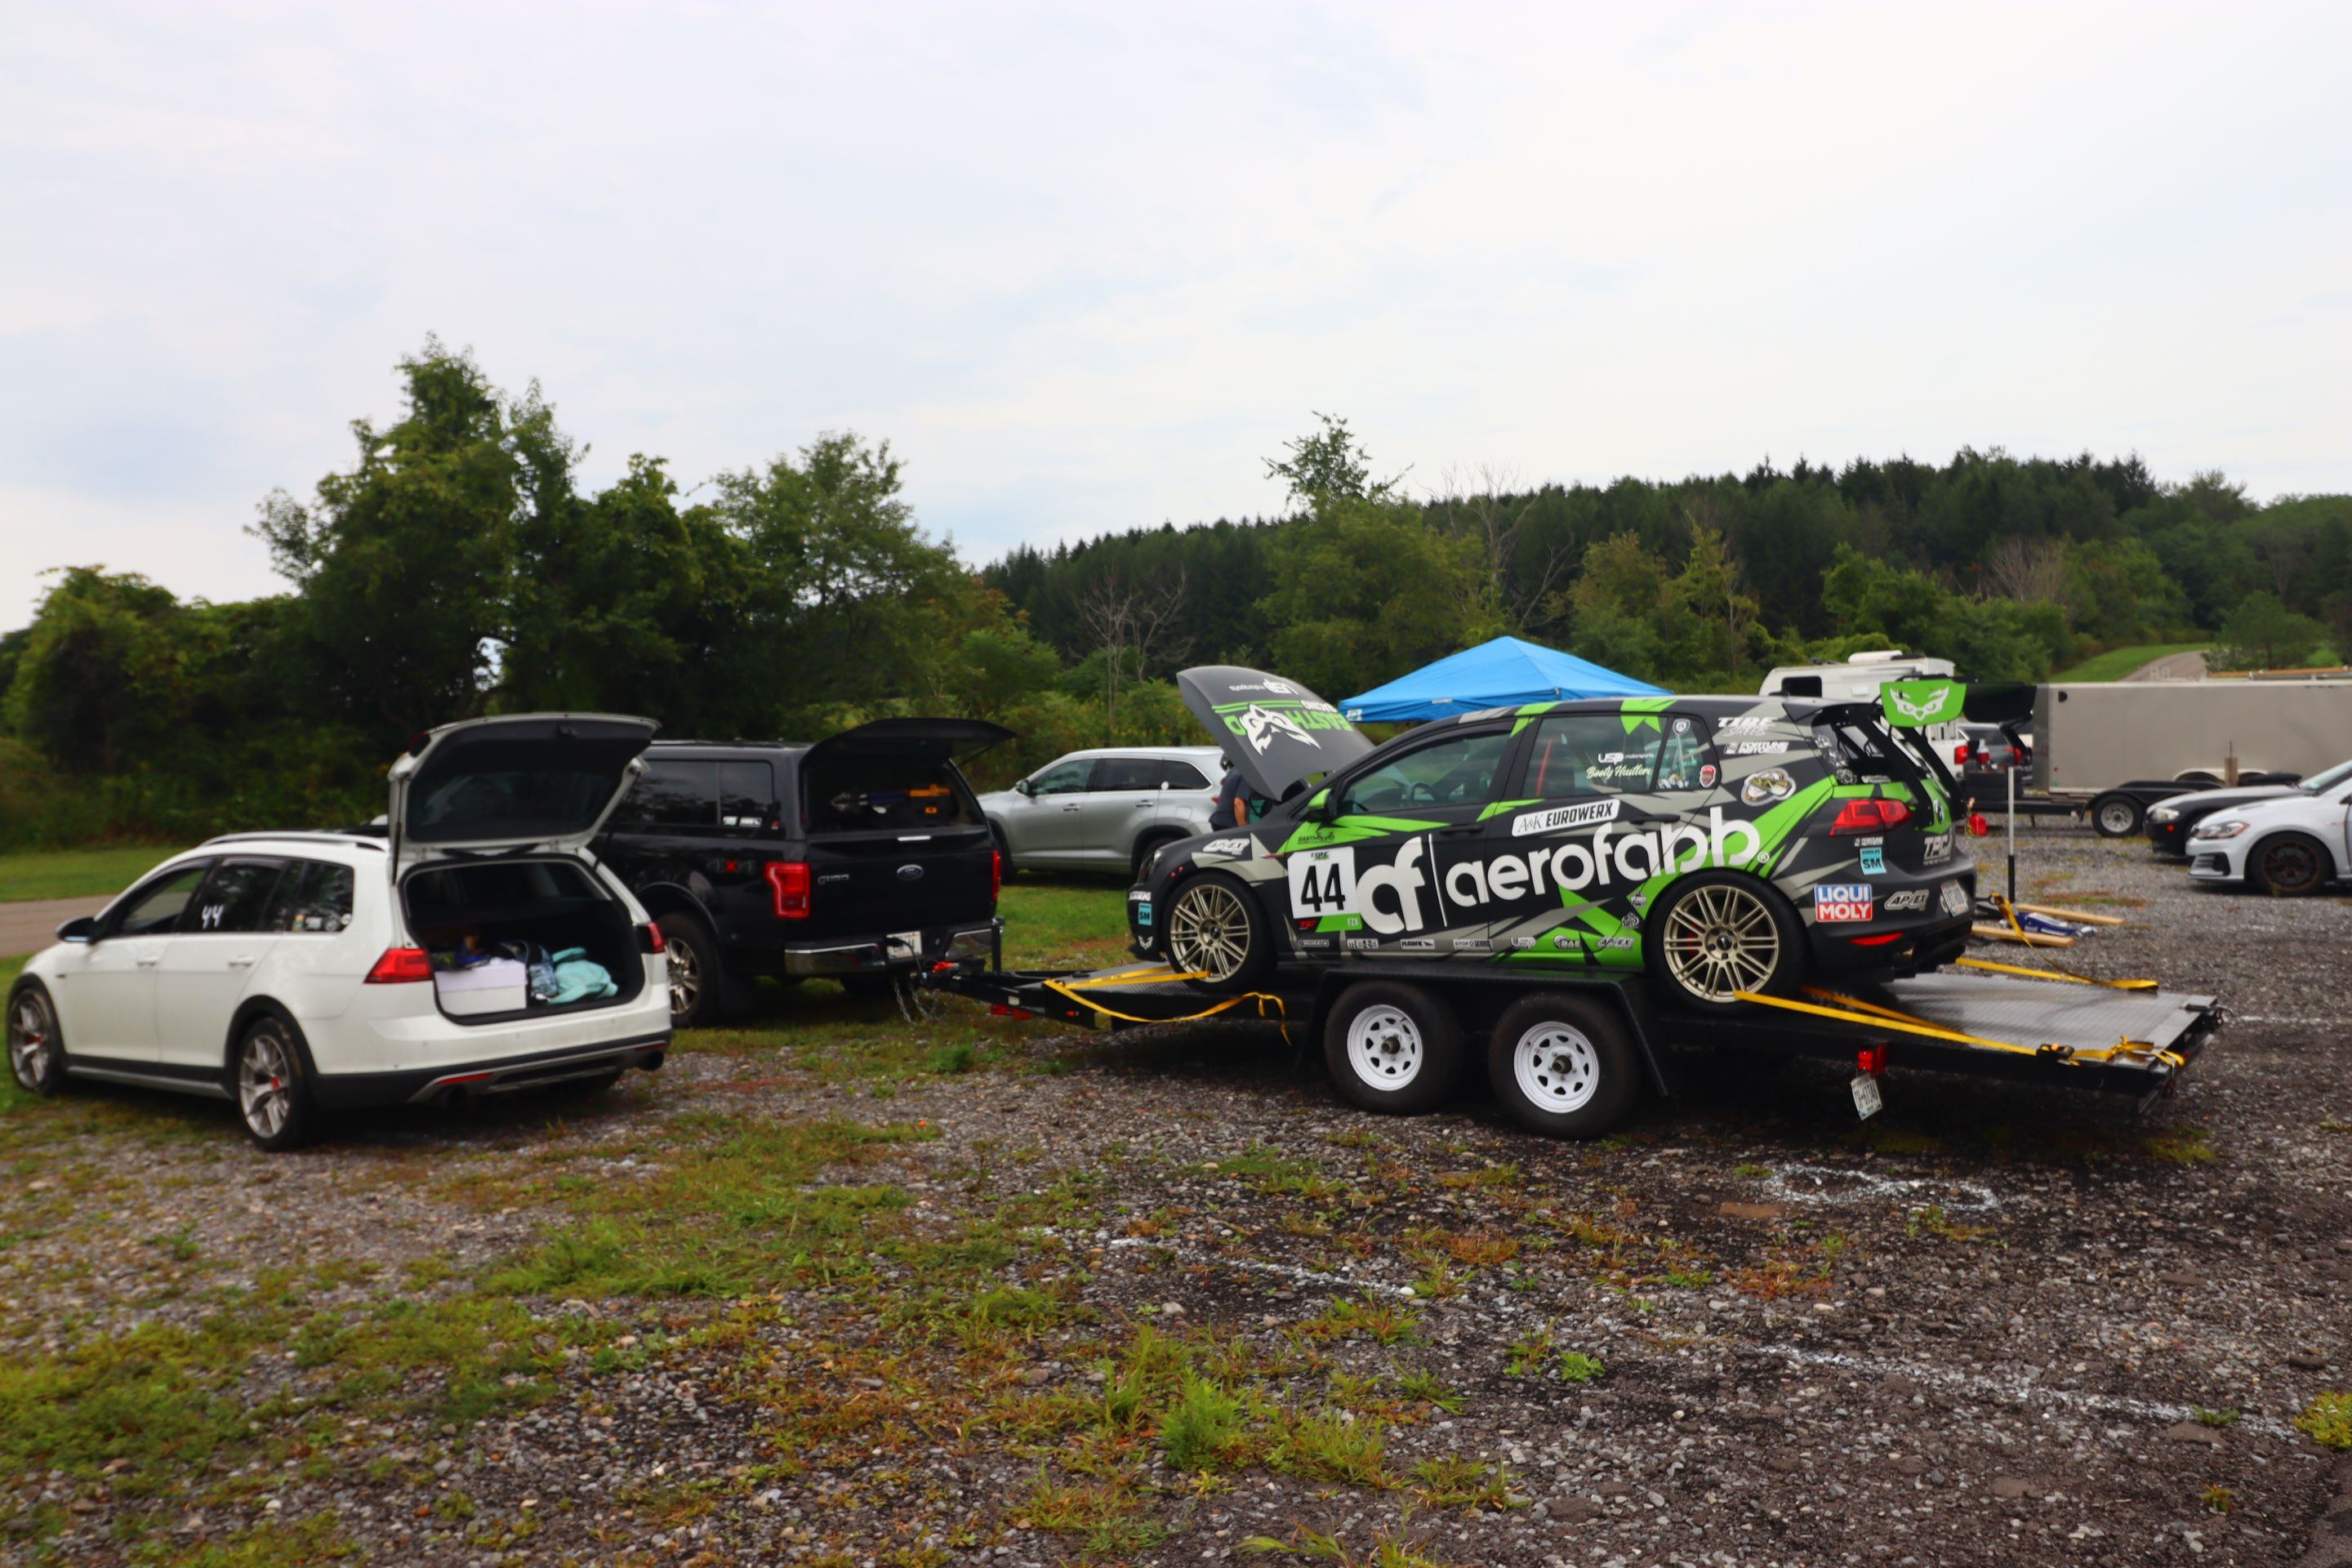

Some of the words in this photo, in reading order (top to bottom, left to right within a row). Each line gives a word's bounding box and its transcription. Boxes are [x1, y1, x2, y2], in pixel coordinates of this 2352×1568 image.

[1517, 815, 1544, 832] A&K
[1546, 802, 1613, 827] EUROWERX
[1862, 858, 1882, 870] SM
[1301, 862, 1346, 912] 44
[1818, 886, 1869, 902] LIQUI
[1139, 911, 1150, 921] SM
[1819, 903, 1870, 920] MOLY
